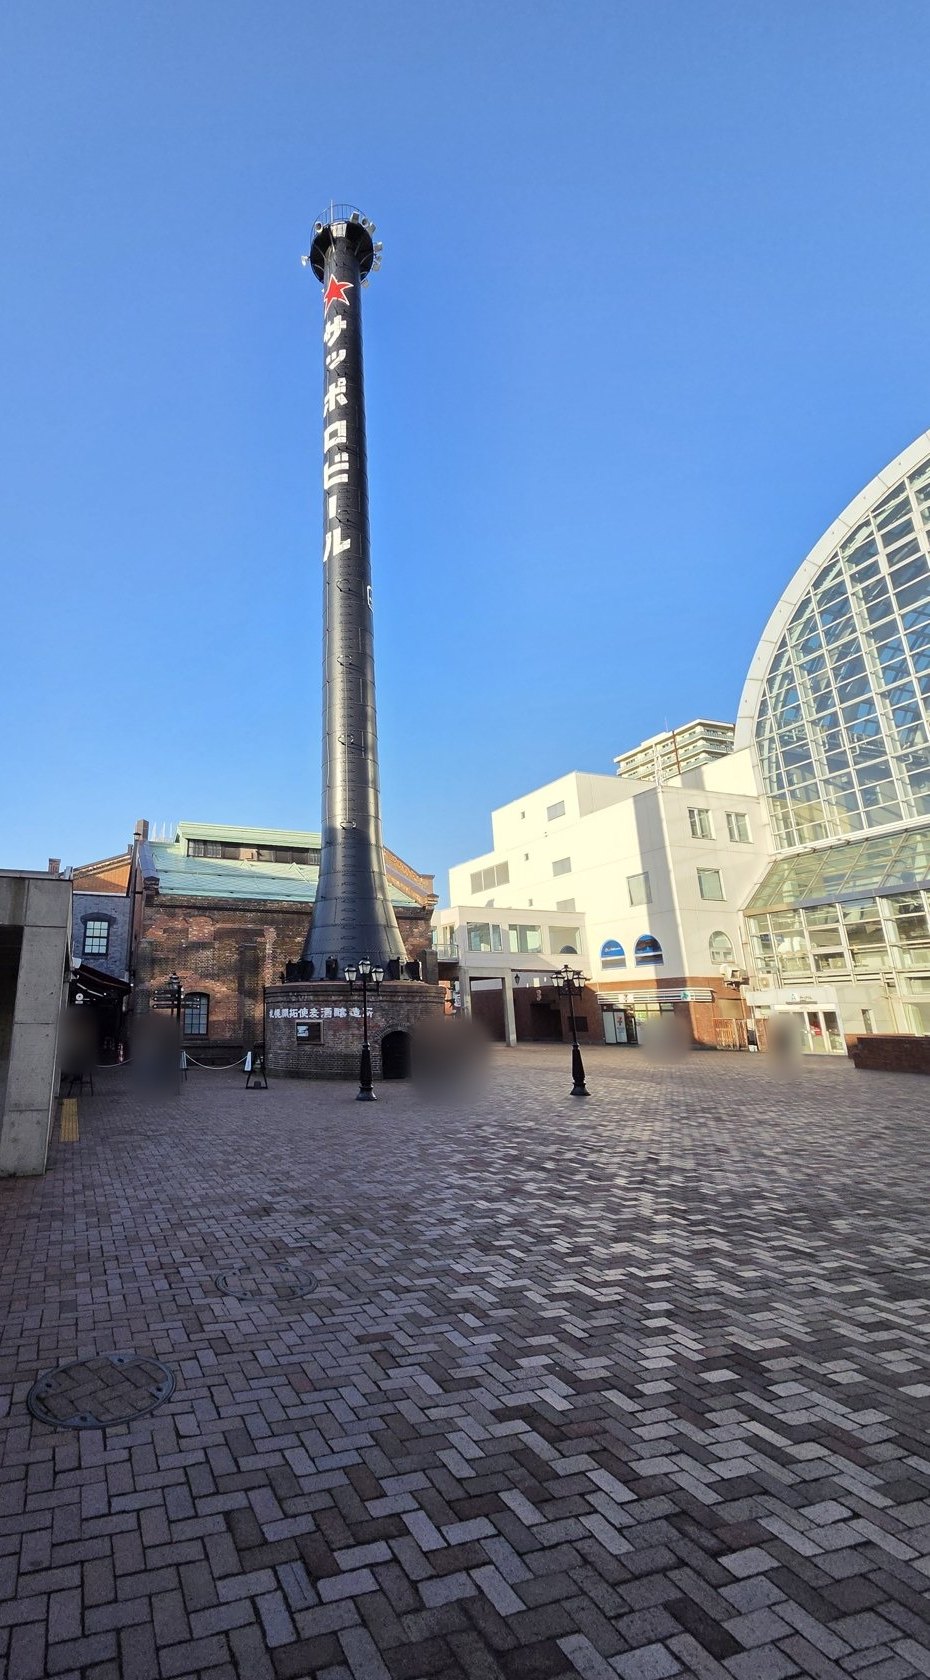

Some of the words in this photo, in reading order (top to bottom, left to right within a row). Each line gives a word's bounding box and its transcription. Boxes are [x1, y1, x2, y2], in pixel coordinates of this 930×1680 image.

[323, 315, 350, 562] サッポロビール
